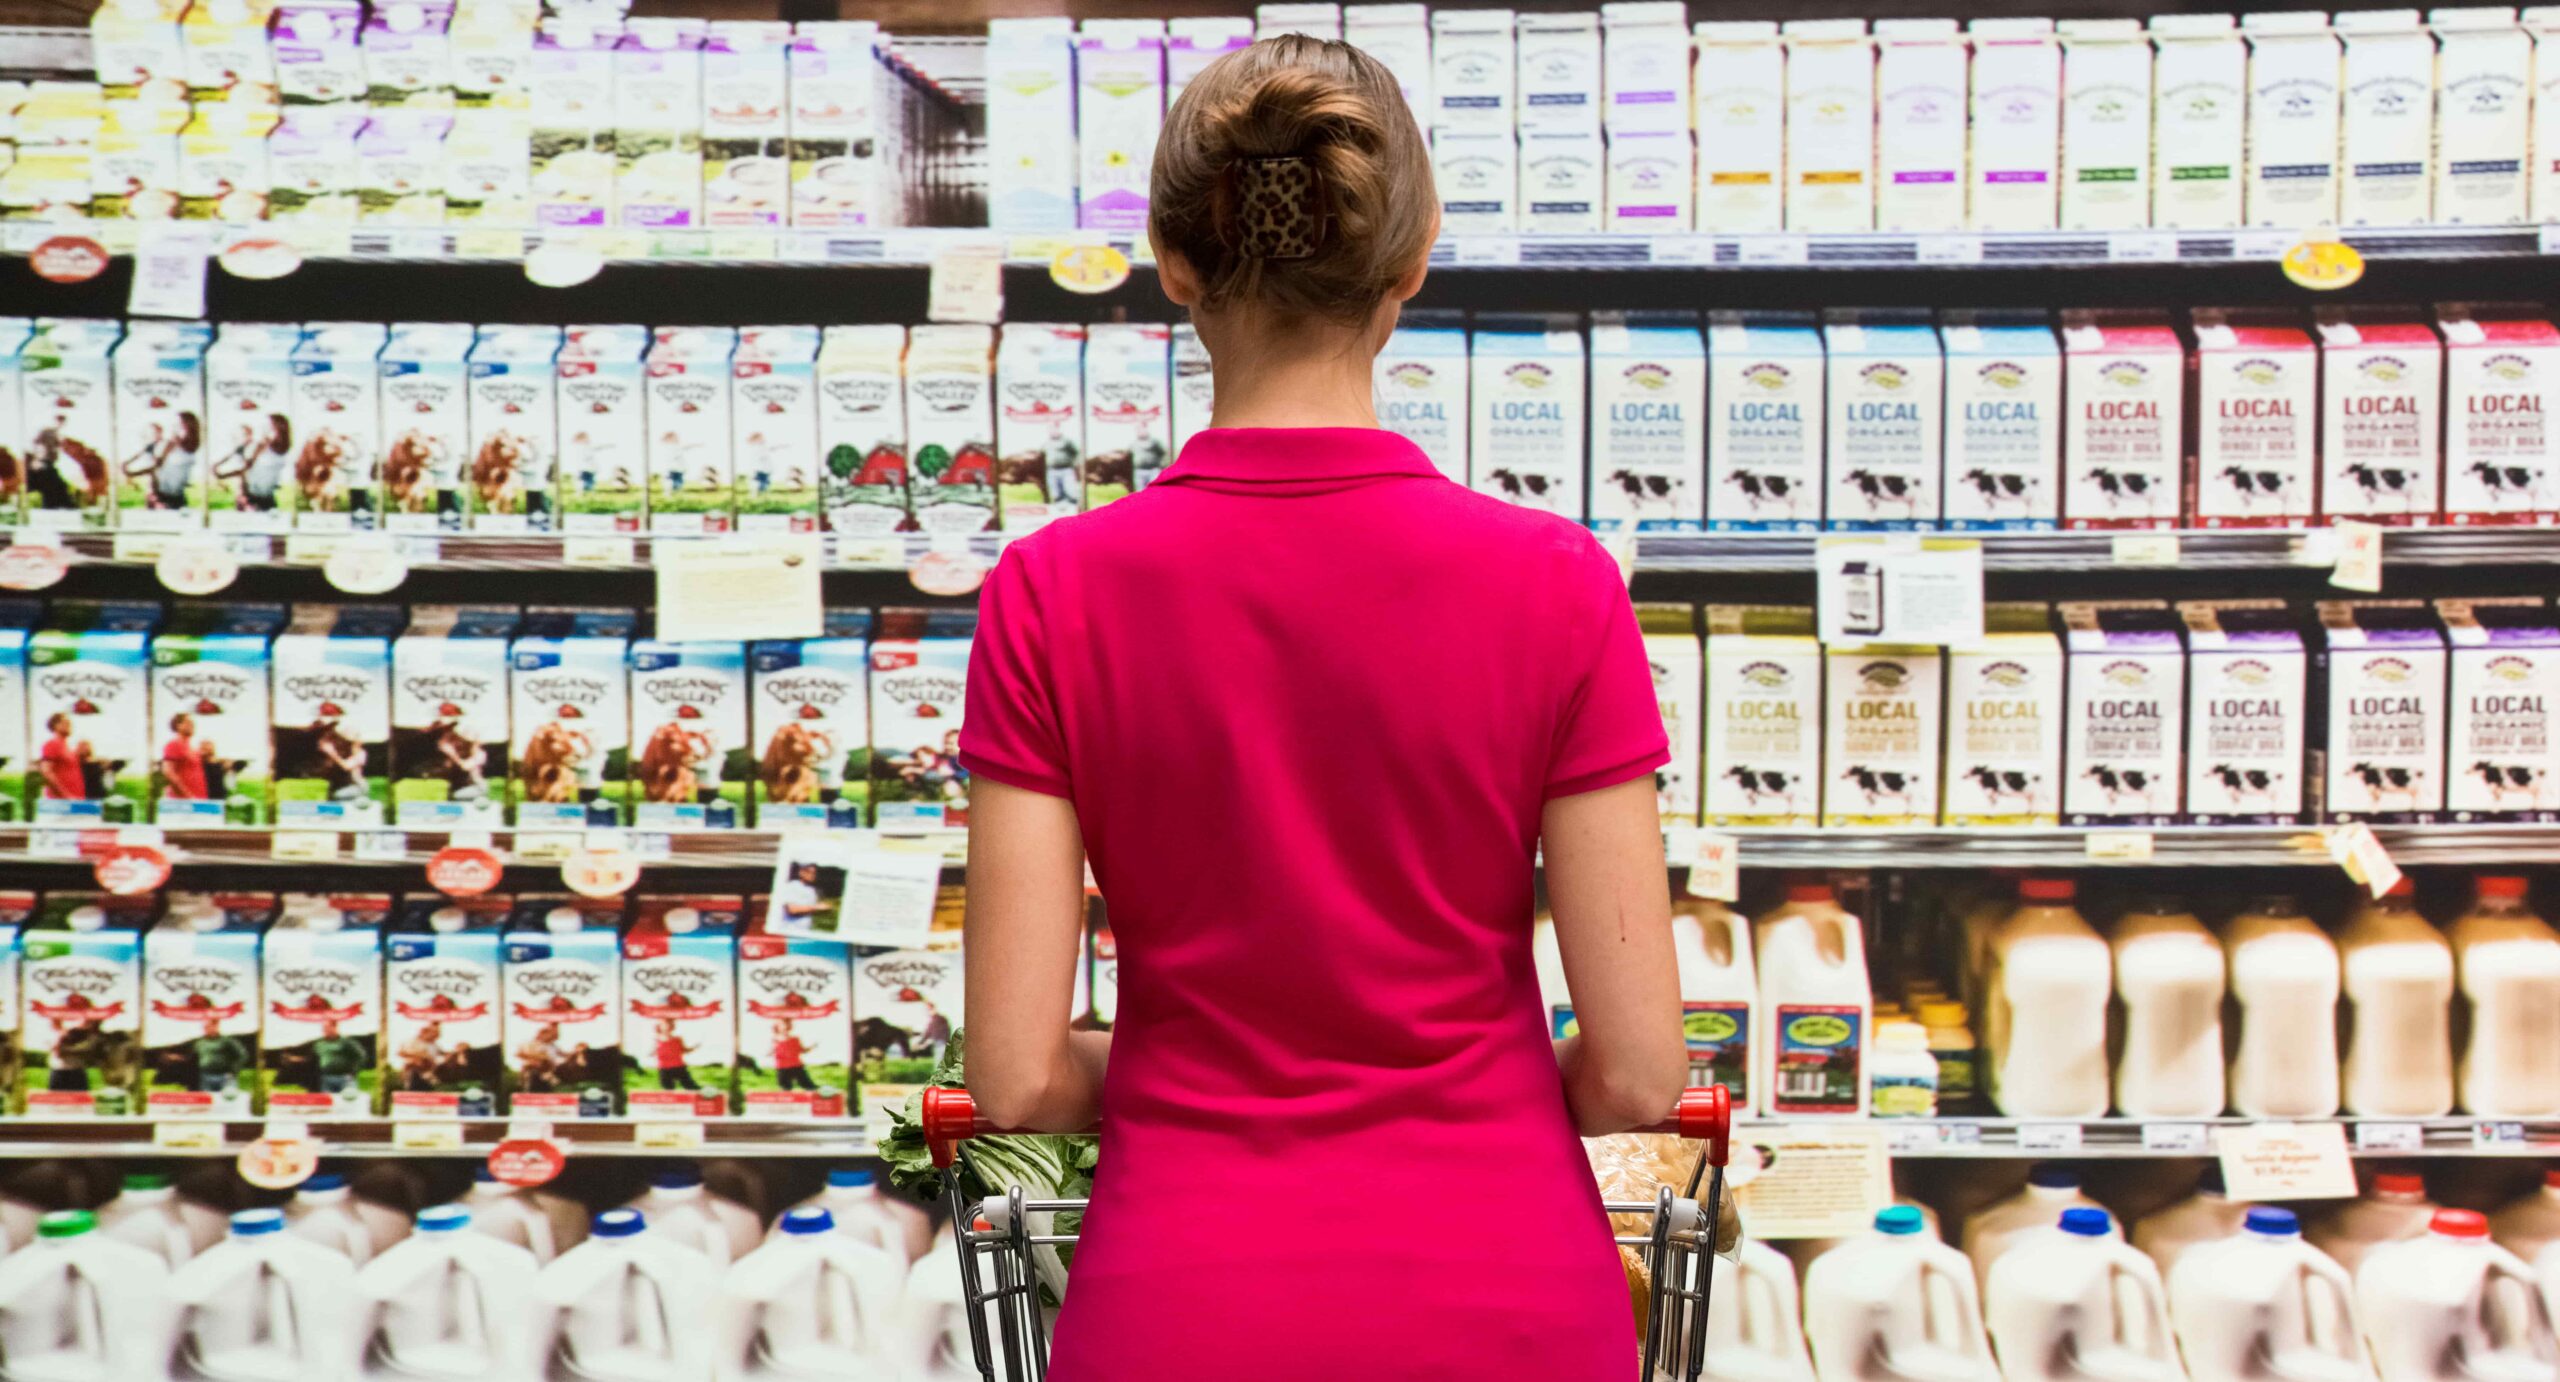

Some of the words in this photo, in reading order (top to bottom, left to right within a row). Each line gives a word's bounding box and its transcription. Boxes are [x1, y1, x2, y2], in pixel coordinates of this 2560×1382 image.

[1491, 402, 1564, 420] LOCAL
[1610, 403, 1684, 421] LOCAL
[1730, 402, 1803, 421] LOCAL
[1847, 402, 1921, 421] LOCAL
[1965, 402, 2039, 421] LOCAL
[2086, 401, 2160, 420] LOCAL
[2219, 399, 2295, 418] LOCAL
[2343, 396, 2420, 415] LOCAL
[2467, 394, 2545, 413] LOCAL
[41, 673, 124, 690] ORGANIC
[162, 673, 248, 690] ORGANIC
[285, 673, 371, 691] ORGANIC
[404, 674, 491, 692] ORGANIC
[524, 676, 609, 694] ORGANIC
[644, 676, 729, 694] ORGANIC
[766, 676, 851, 694] ORGANIC
[50, 686, 116, 700] VALLEY
[171, 686, 238, 700] VALLEY
[295, 687, 361, 701] VALLEY
[415, 688, 480, 702] VALLEY
[534, 690, 598, 704] VALLEY
[654, 691, 718, 705] VALLEY
[776, 691, 840, 705] VALLEY
[894, 691, 957, 704] VALLEY
[1726, 700, 1802, 720] LOCAL
[1845, 700, 1919, 720] LOCAL
[1967, 700, 2042, 720] LOCAL
[2087, 700, 2162, 718] LOCAL
[2210, 699, 2285, 718] LOCAL
[2349, 697, 2425, 716] LOCAL
[2471, 696, 2547, 714] LOCAL
[33, 967, 120, 985] ORGANIC
[154, 967, 240, 984] ORGANIC
[274, 968, 356, 985] ORGANIC
[399, 968, 485, 986] ORGANIC
[516, 969, 602, 986] ORGANIC
[634, 967, 719, 984] ORGANIC
[751, 966, 835, 983] ORGANIC
[865, 961, 949, 978] ORGANIC
[43, 981, 109, 994] VALLEY
[164, 980, 230, 994] VALLEY
[283, 981, 348, 995] VALLEY
[409, 981, 473, 995] VALLEY
[526, 982, 590, 996] VALLEY
[643, 979, 708, 993] VALLEY
[760, 978, 826, 993] VALLEY
[875, 974, 940, 988] VALLEY
